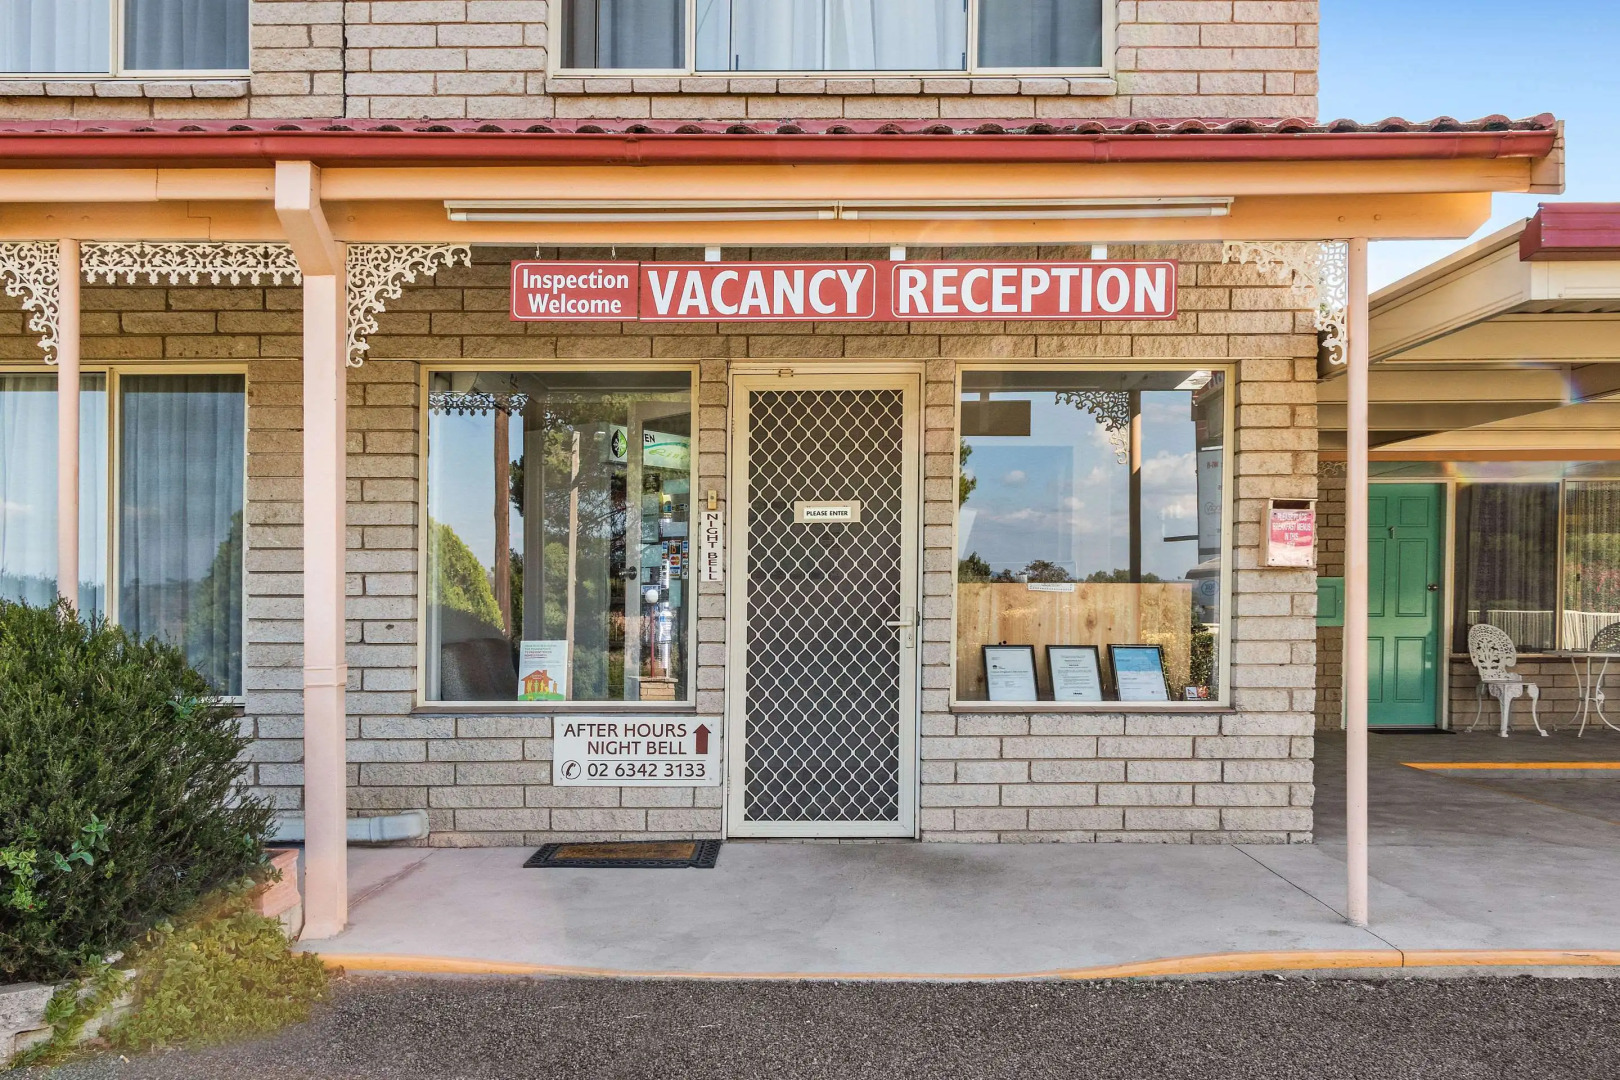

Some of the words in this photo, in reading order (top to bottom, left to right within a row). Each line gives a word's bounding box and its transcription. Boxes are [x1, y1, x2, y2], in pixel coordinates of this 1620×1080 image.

[522, 268, 629, 295] Inspection
[647, 269, 868, 315] VACANCY
[899, 267, 1166, 314] RECEPTION
[528, 293, 622, 313] Welcome
[706, 513, 719, 549] NIGHT
[707, 552, 718, 581] BELL
[563, 723, 618, 738] AFTER
[624, 723, 687, 738] HOURS
[587, 741, 641, 755] NIGHT
[646, 741, 687, 755] BELL
[587, 763, 608, 777] 02
[615, 763, 658, 777] 6342
[664, 763, 706, 777] 3133
